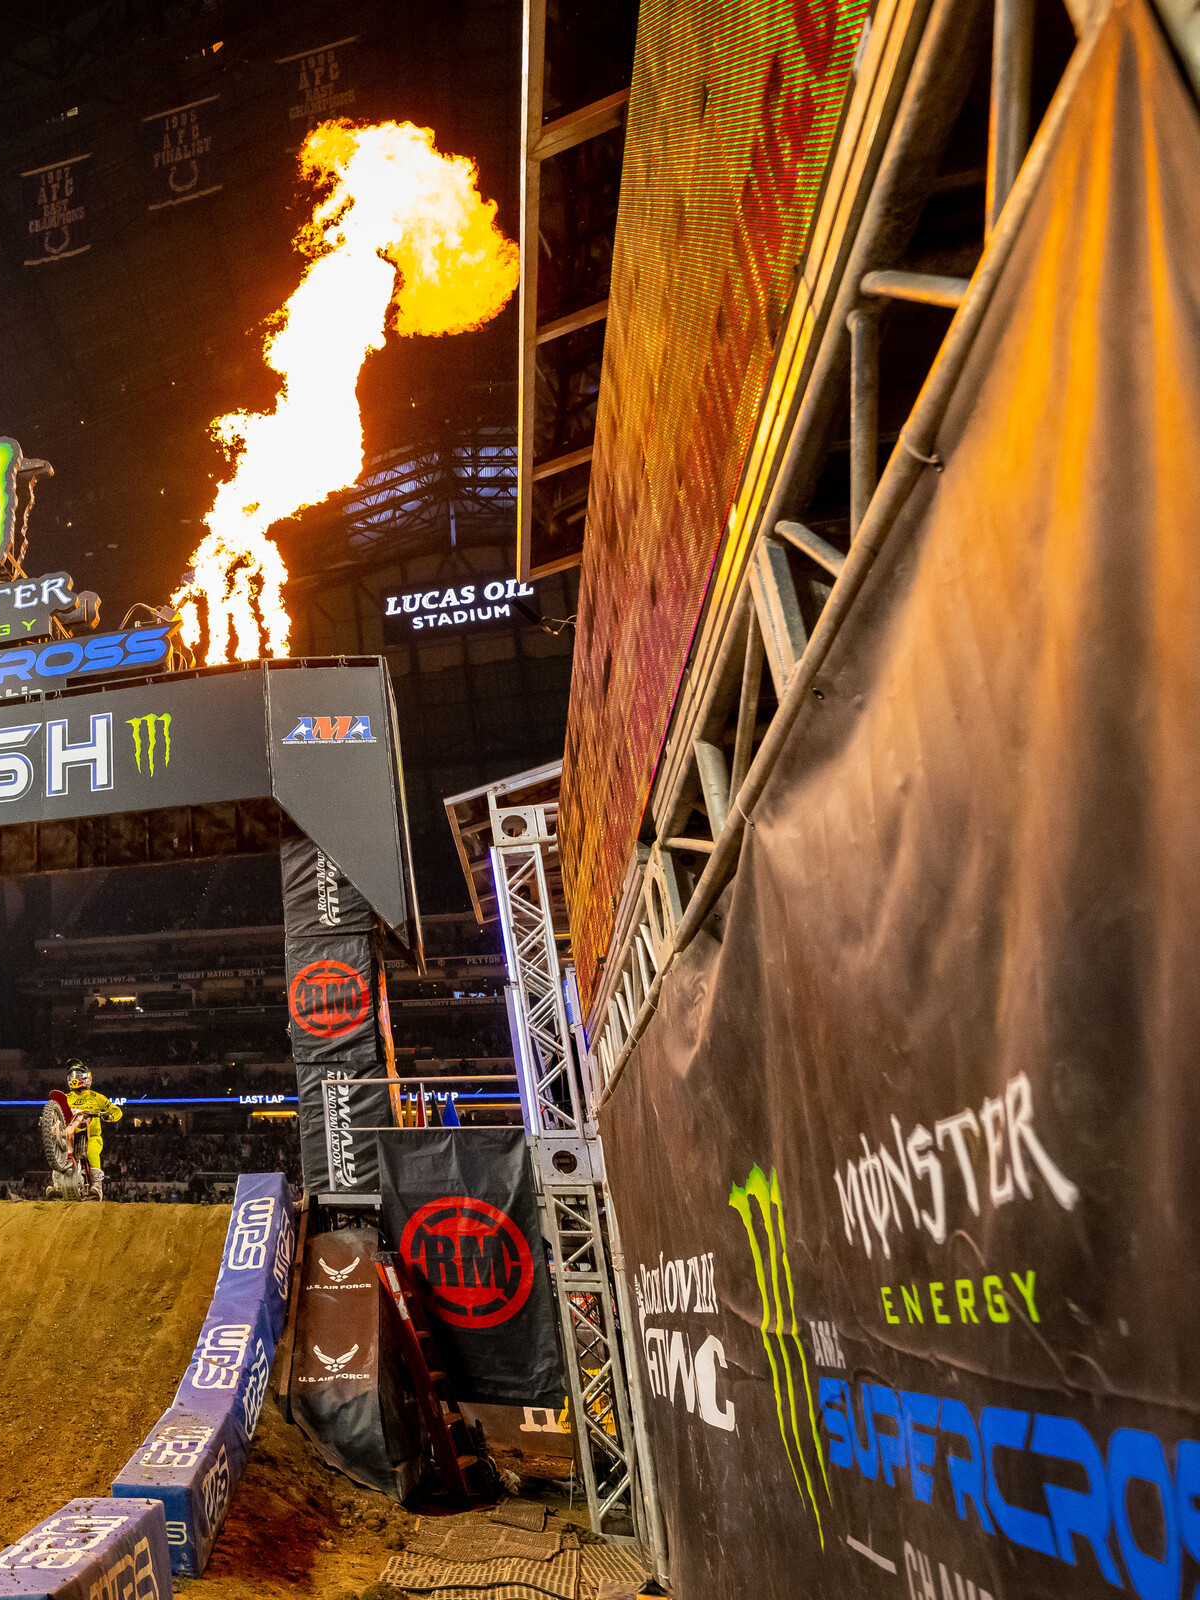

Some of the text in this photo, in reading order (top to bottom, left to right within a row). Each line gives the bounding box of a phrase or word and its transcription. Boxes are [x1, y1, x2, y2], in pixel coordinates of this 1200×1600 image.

[385, 578, 534, 615] LUCAS OIL
[412, 604, 511, 629] STADIUM
[281, 716, 377, 740] AMA
[467, 957, 500, 966] PEYTON
[178, 970, 205, 980] ROBERT
[207, 969, 234, 979] MATHIS
[109, 1097, 127, 1106] LAP
[239, 1094, 285, 1104] LAST LAP
[409, 1092, 435, 1101] LST
[833, 1070, 1079, 1259] MONSTER
[228, 1197, 275, 1270] WPS
[881, 1270, 1041, 1325] ENERGY
[192, 1324, 251, 1389] WPS
[810, 1320, 846, 1369] AMA
